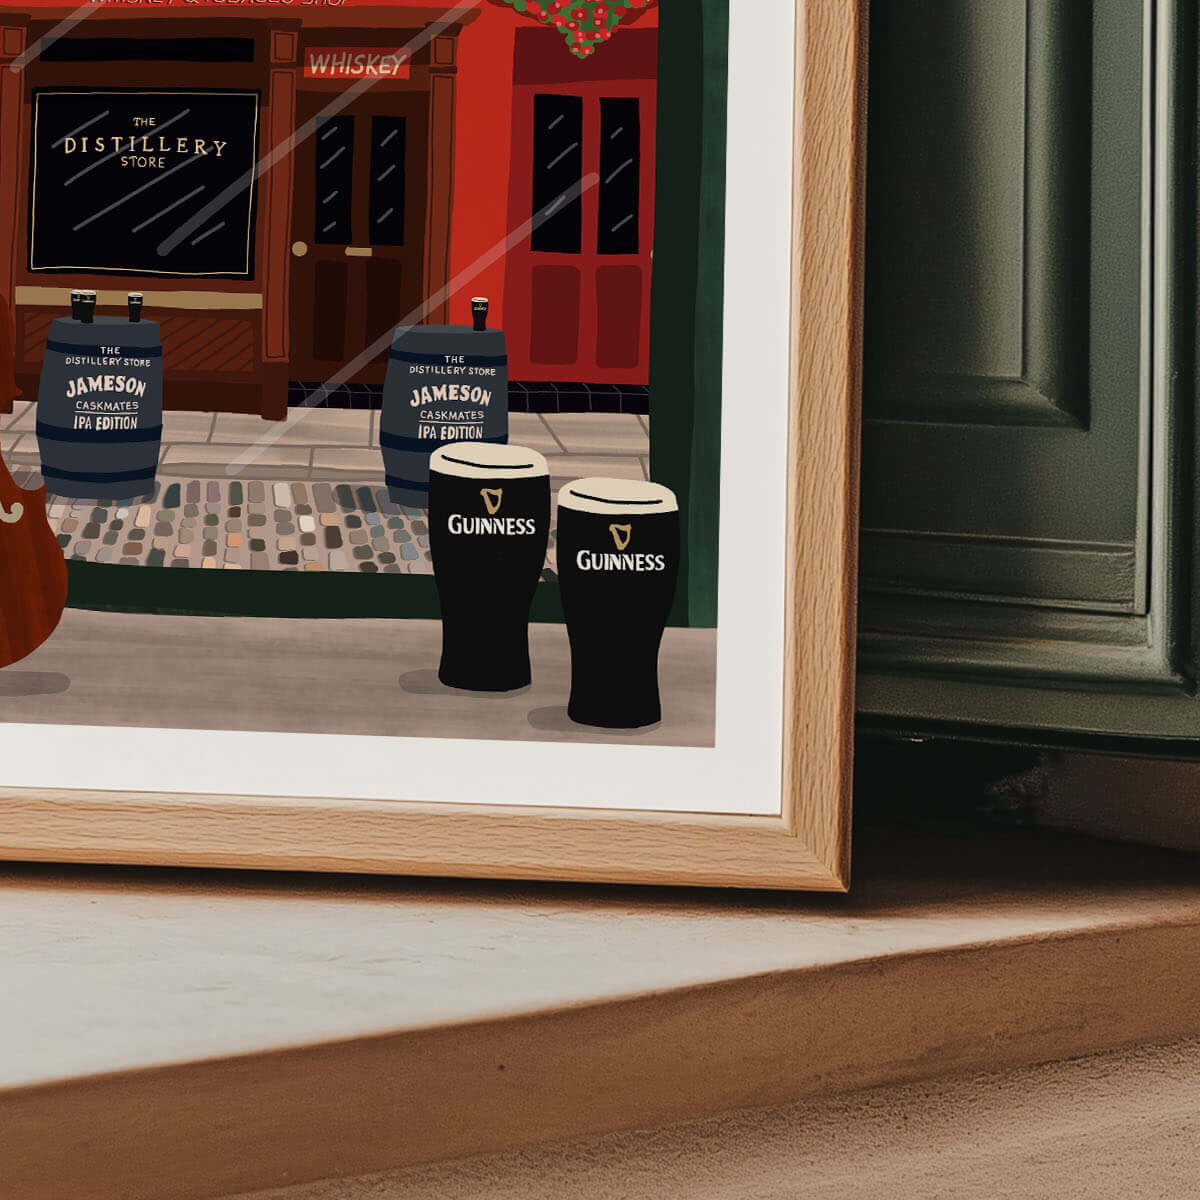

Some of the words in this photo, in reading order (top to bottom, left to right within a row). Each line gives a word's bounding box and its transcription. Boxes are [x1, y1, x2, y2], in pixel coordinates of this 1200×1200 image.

[309, 51, 408, 76] WHISKEY
[132, 117, 157, 127] THE
[64, 135, 228, 157] DISTILLERY
[120, 155, 166, 169] STORE
[100, 346, 121, 355] THE
[65, 357, 122, 367] DISTILLERY
[123, 358, 151, 368] STORE
[444, 355, 465, 364] THE
[409, 365, 467, 375] DISTILLERY
[468, 366, 496, 376] STORE
[65, 374, 147, 398] JAMESON
[409, 383, 493, 408] JAMESON
[75, 400, 140, 411] CASKMATES
[419, 409, 485, 421] CASKMATES
[73, 415, 93, 430] IPA
[95, 415, 139, 431] EDITION
[417, 424, 437, 440] IPA
[440, 424, 484, 441] EDITION
[447, 513, 536, 536] GUINNESS
[576, 549, 666, 572] GUINNESS
